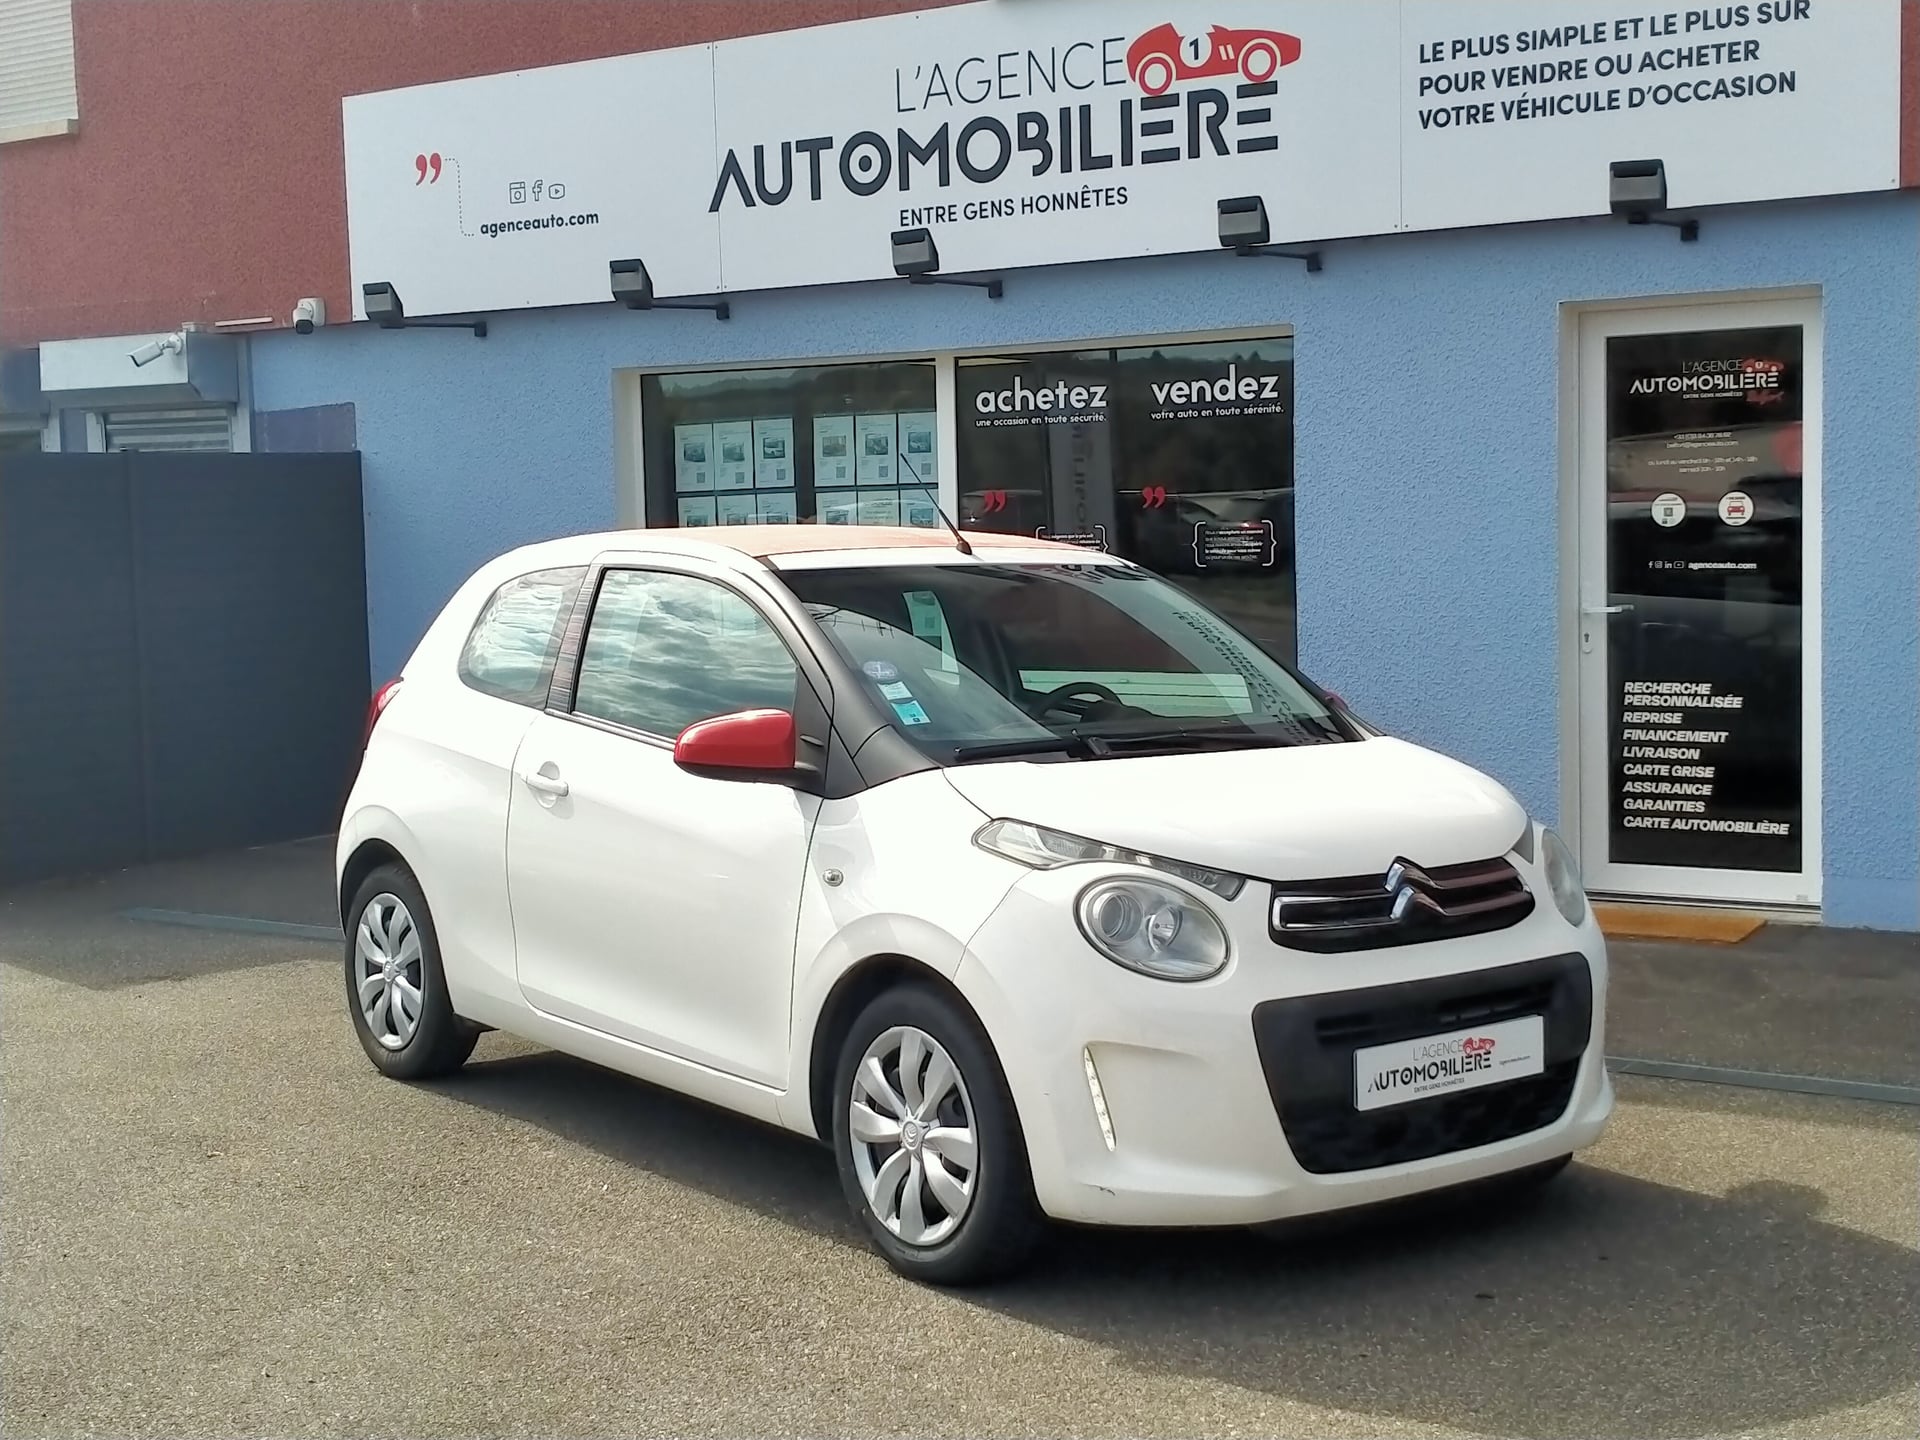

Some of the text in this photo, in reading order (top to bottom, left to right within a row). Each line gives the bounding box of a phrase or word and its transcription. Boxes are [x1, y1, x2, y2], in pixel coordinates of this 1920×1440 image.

[1419, 0, 1811, 63] LE PLUS SIMPLE ET LE PLUS SUR
[896, 37, 1126, 112] L'AGENCE
[1419, 39, 1760, 96] POUR VENDRE OU ACHETER
[1419, 70, 1797, 130] VOTRE VÉHICULE D'OCCASION
[900, 184, 1129, 227] ENTRE GENS HONNÊTES
[480, 213, 599, 238] agenceauto.com
[1682, 359, 1742, 374] L'AGENCE
[1151, 364, 1279, 405] vendez
[976, 376, 1107, 413] achetez
[1151, 403, 1284, 420] votre auto en toute sérénité.
[976, 412, 1107, 427] une occasion en toute sécurité.
[1688, 562, 1757, 570] agenceauto.com
[1624, 682, 1712, 694] RECHERCHE
[1624, 694, 1743, 708] PERSONNALISÉE
[1623, 712, 1683, 724] REPRISE
[1623, 729, 1729, 743] FINANCEMENT
[1623, 746, 1700, 760] LIVRAISON
[1623, 764, 1715, 778] CARTE GRISE
[1622, 781, 1713, 795] ASSURANCE
[1623, 799, 1705, 812] GARANTIES
[1623, 816, 1790, 835] CARTE AUTOMOBILIÈRE
